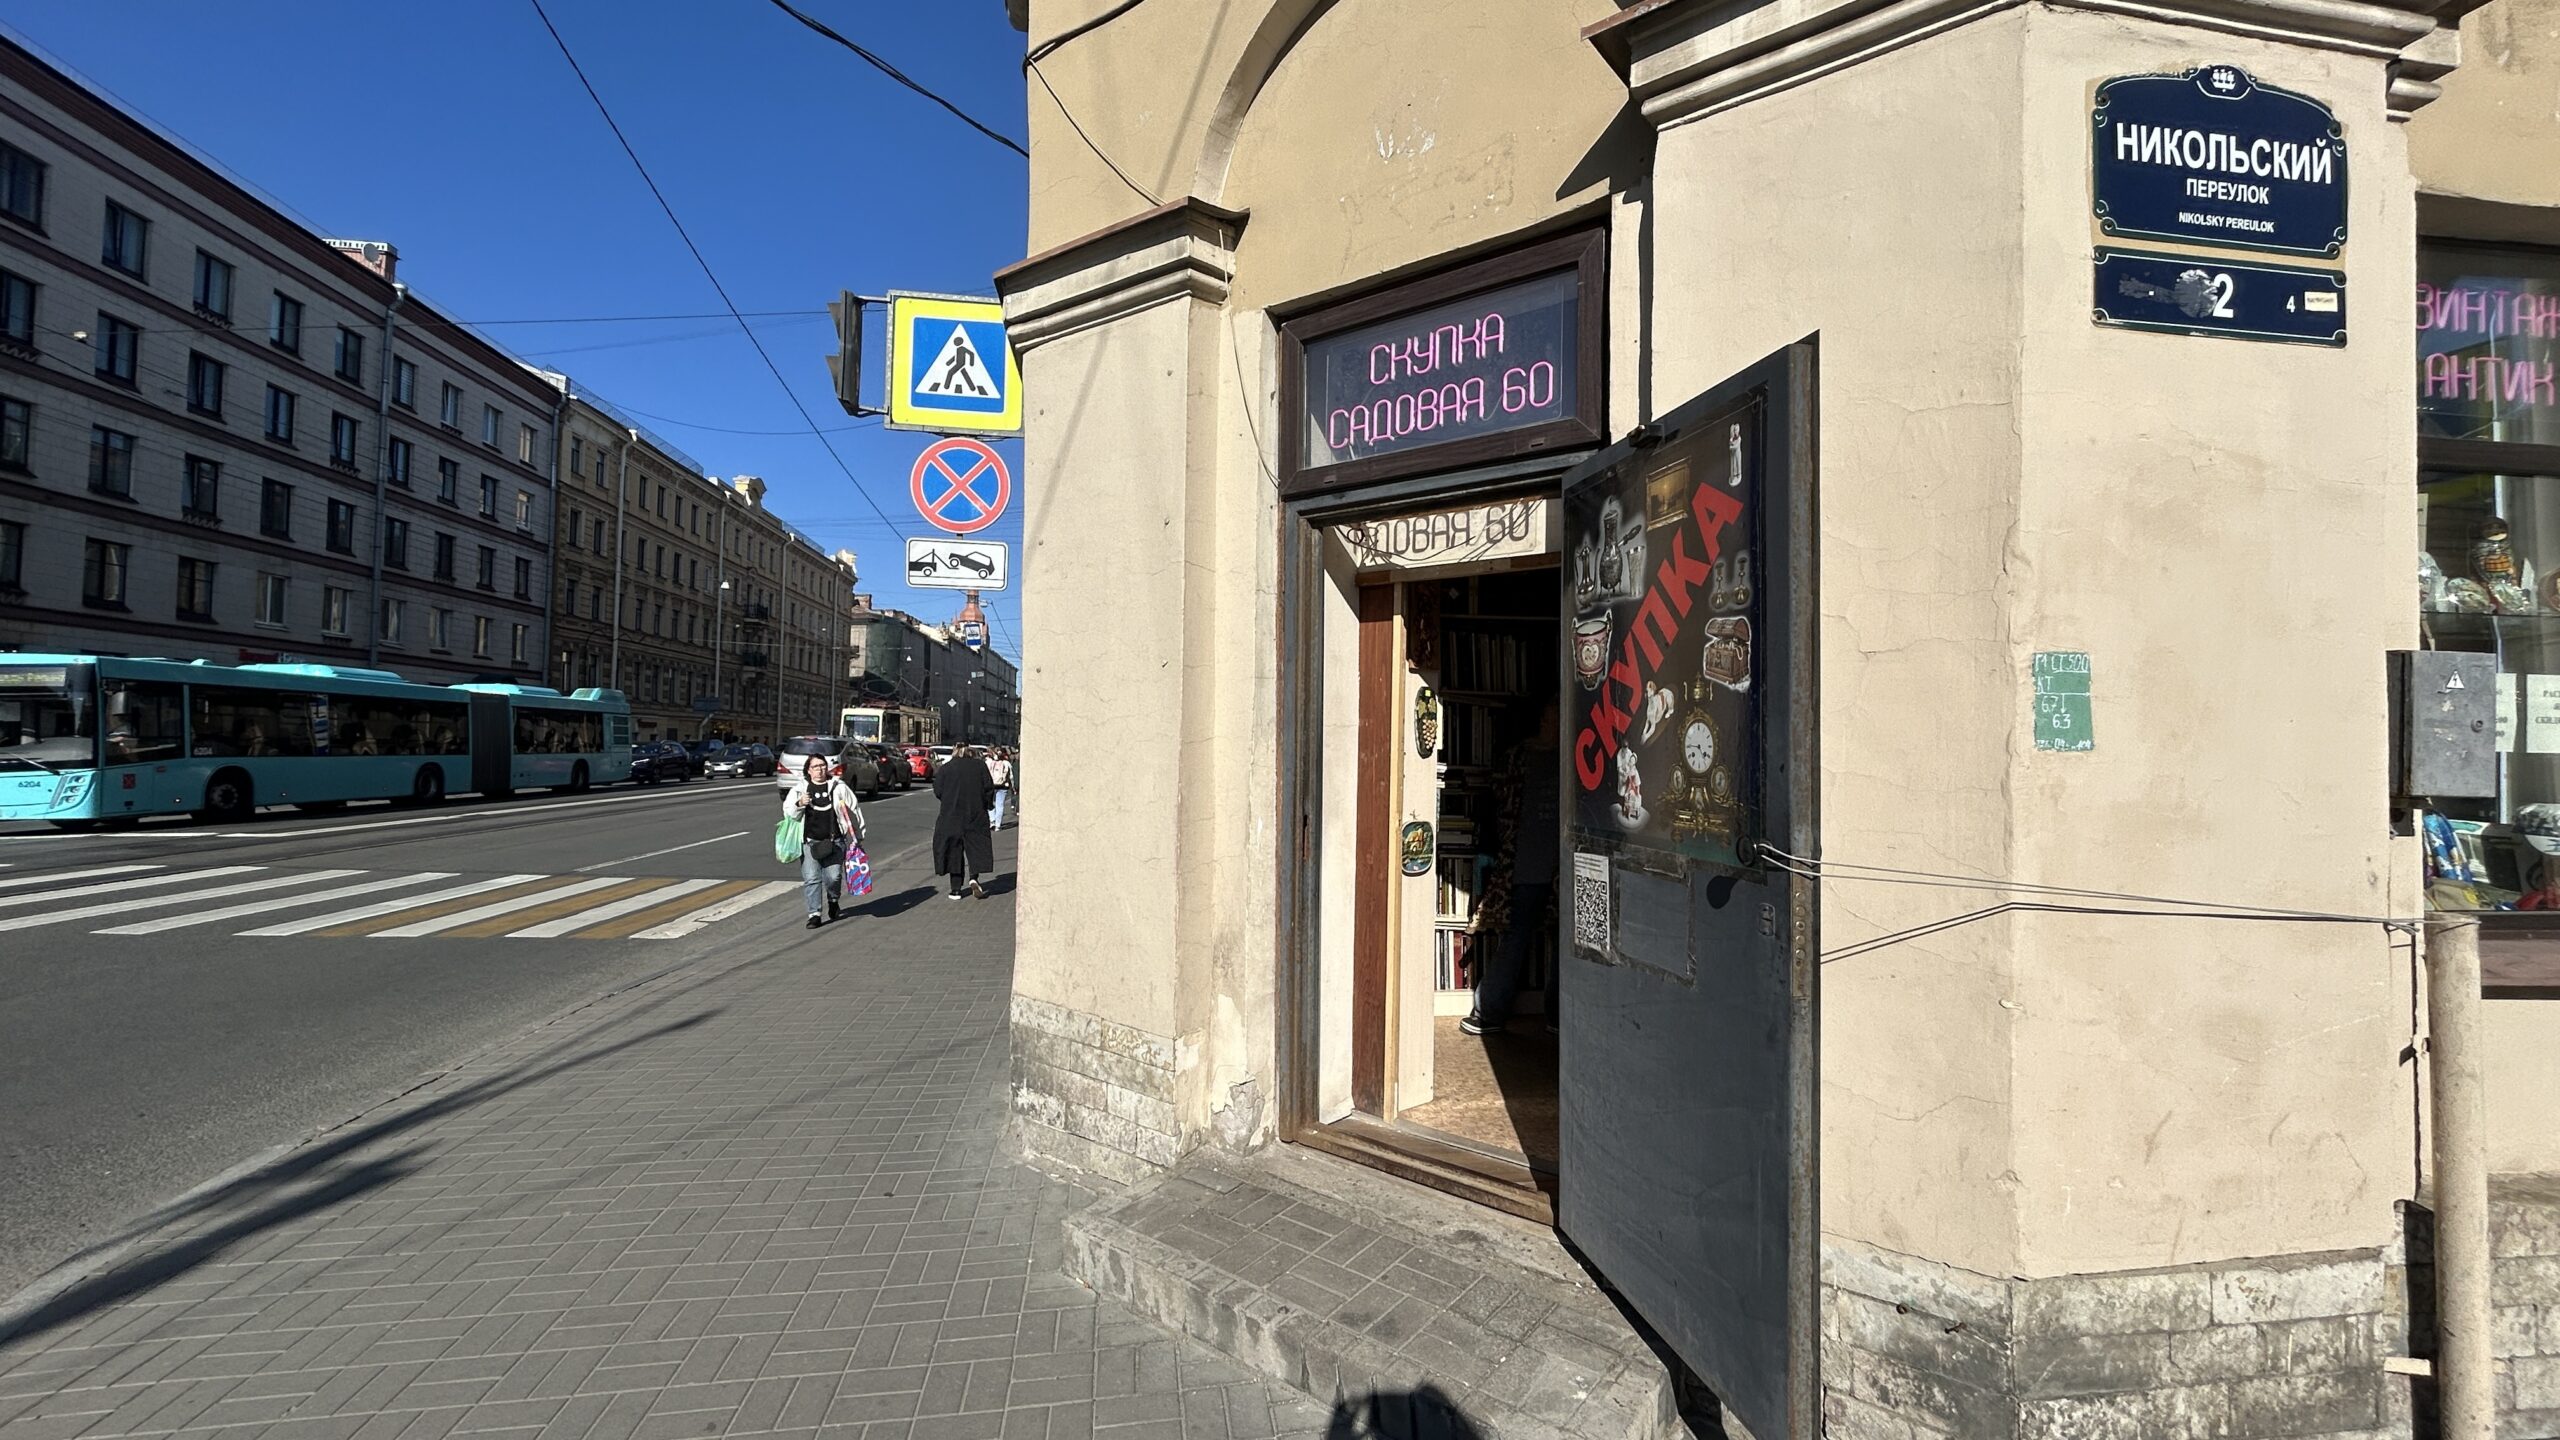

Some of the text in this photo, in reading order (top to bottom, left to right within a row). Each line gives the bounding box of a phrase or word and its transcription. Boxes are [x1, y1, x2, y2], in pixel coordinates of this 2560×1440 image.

[2116, 122, 2332, 185] НИКОЛЬСКИЙ
[2186, 178, 2270, 204] ПЕРЕУЛОК
[2178, 212, 2275, 233] NIKOLSKY PEREULOK
[2212, 273, 2234, 318] 2
[2286, 295, 2296, 313] 4
[1368, 312, 1506, 386] СКУПКА
[2424, 352, 2556, 407] АНТИК
[1328, 360, 1555, 450] САДОВАЯ 60
[1575, 480, 1746, 792] СКУПКА
[17, 780, 41, 789] 6204
